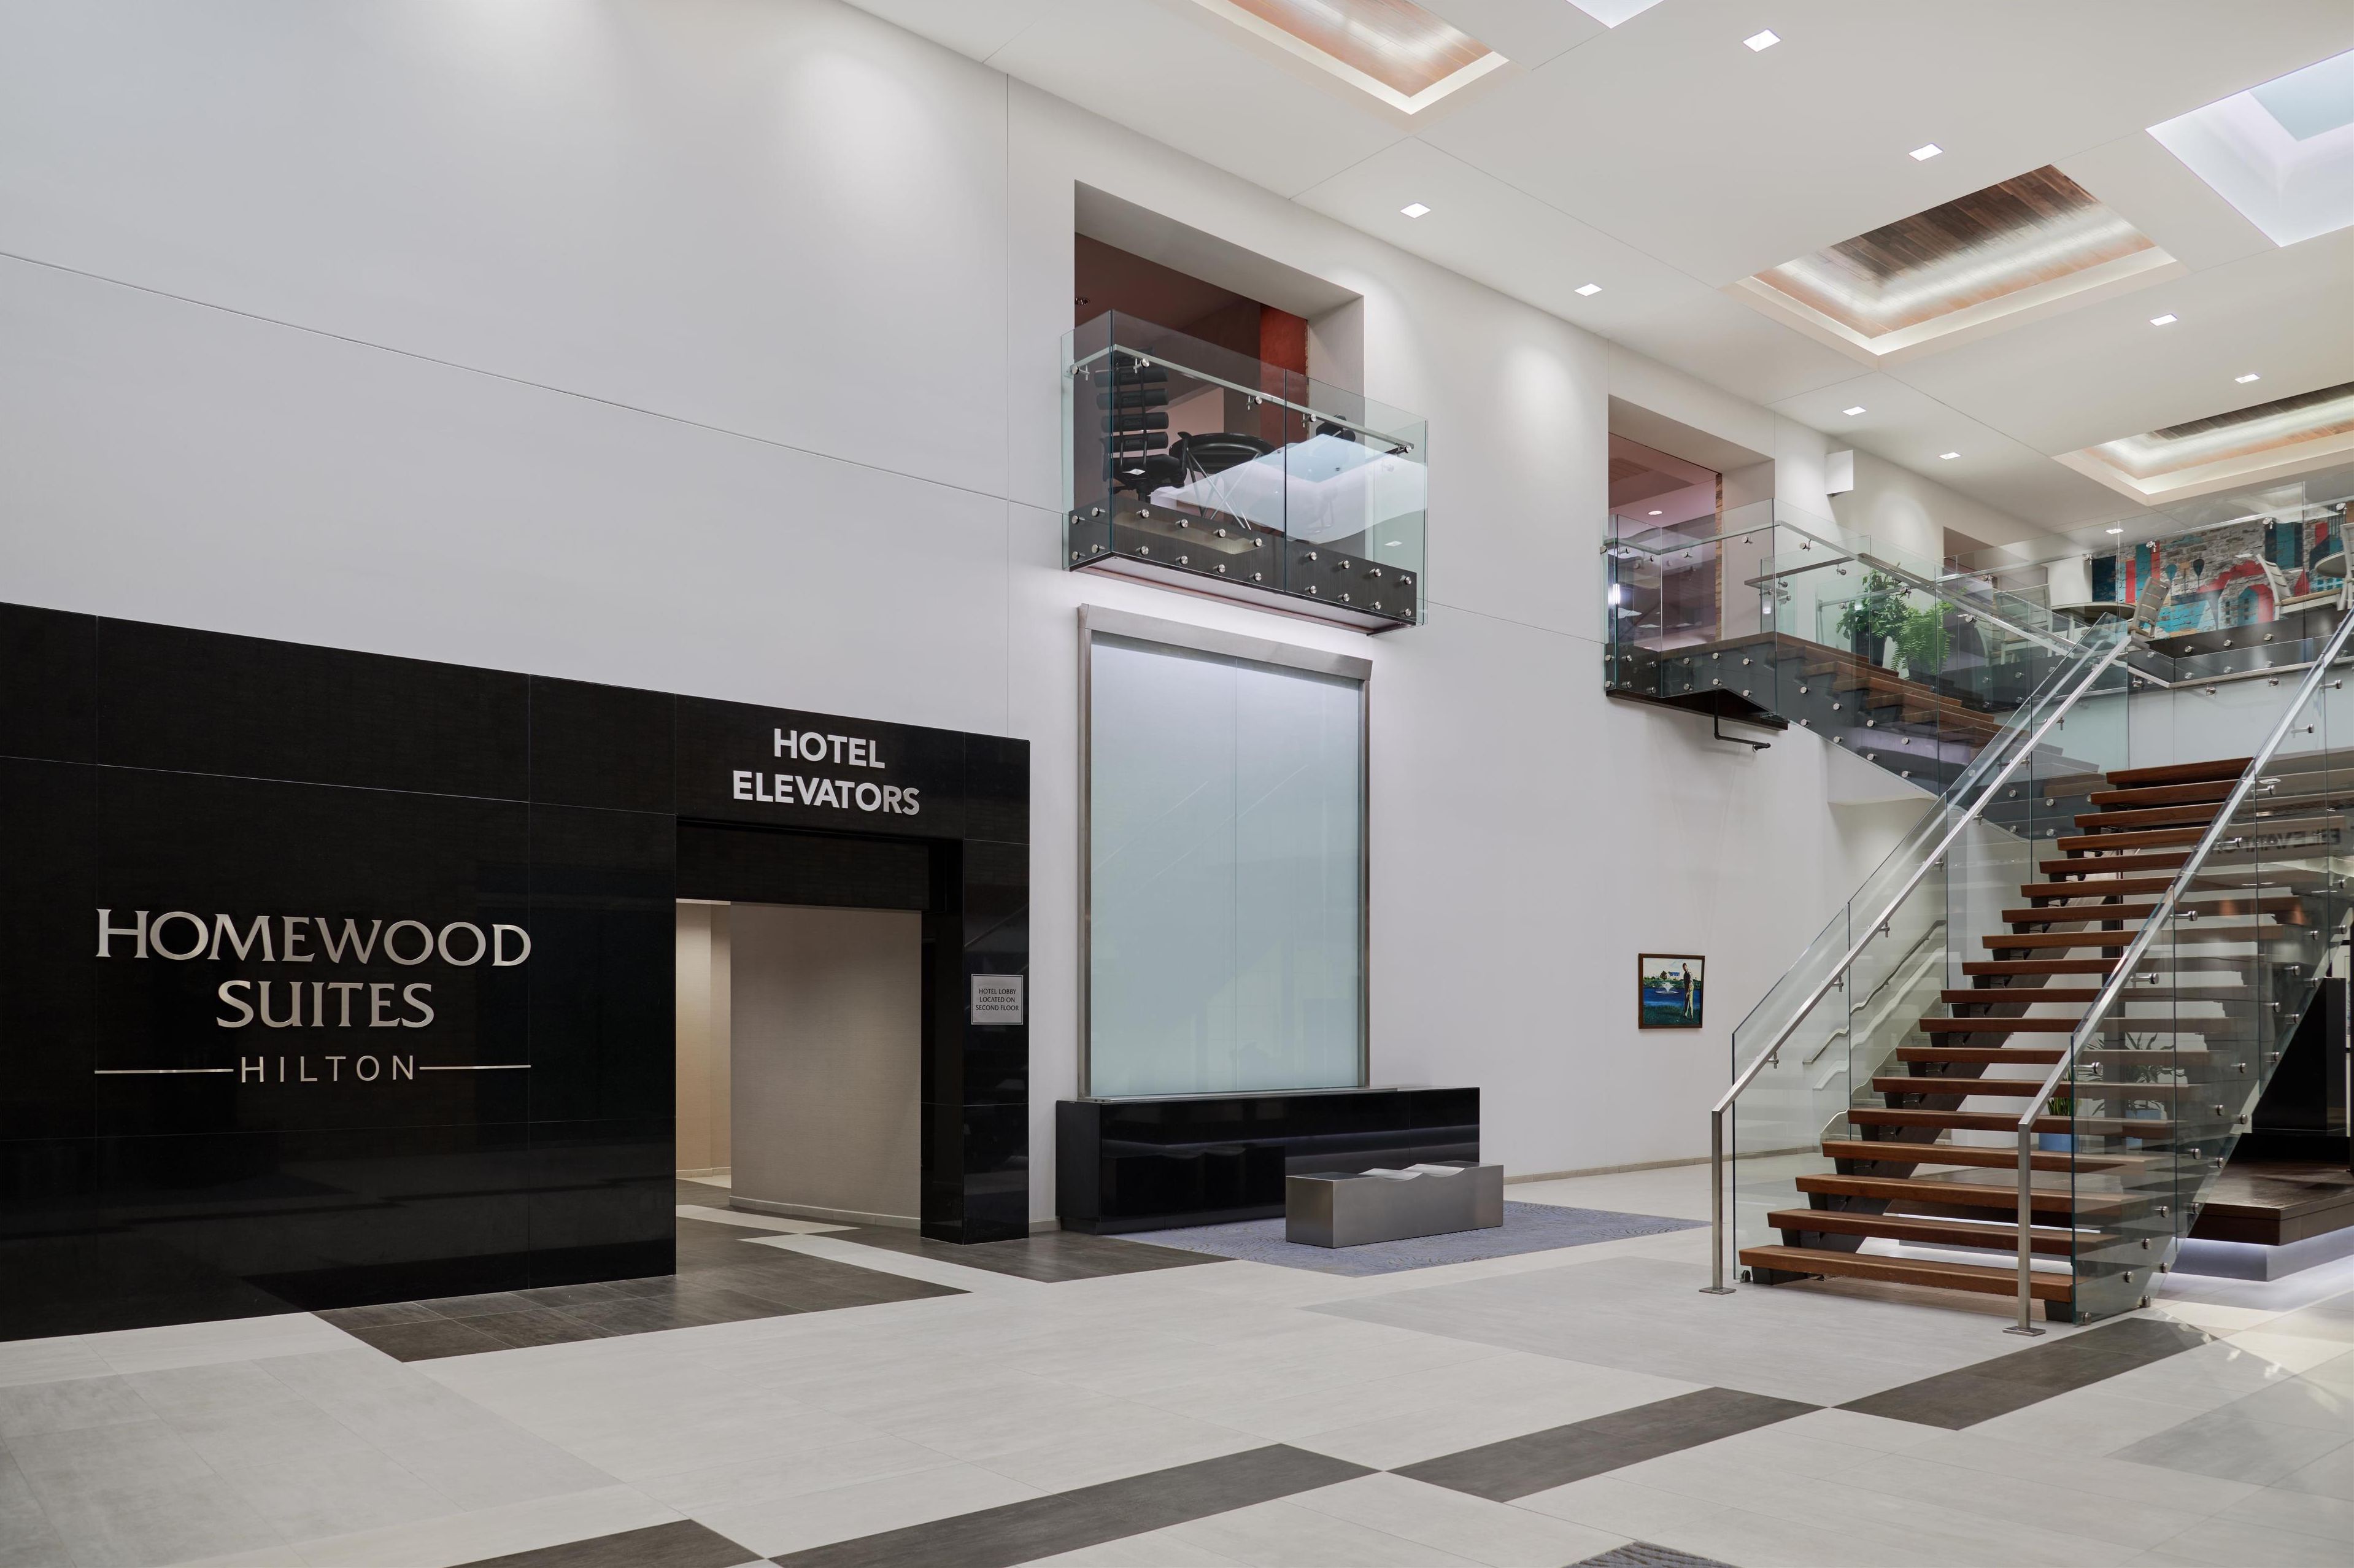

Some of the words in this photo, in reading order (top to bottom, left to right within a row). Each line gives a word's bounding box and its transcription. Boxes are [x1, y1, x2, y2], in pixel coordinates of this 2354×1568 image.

[774, 728, 886, 769] HOTEL
[733, 770, 920, 816] ELEVATORS
[95, 908, 531, 967] HOMEWOOD
[216, 979, 434, 1028] SUITES
[241, 1055, 415, 1083] HILTON
